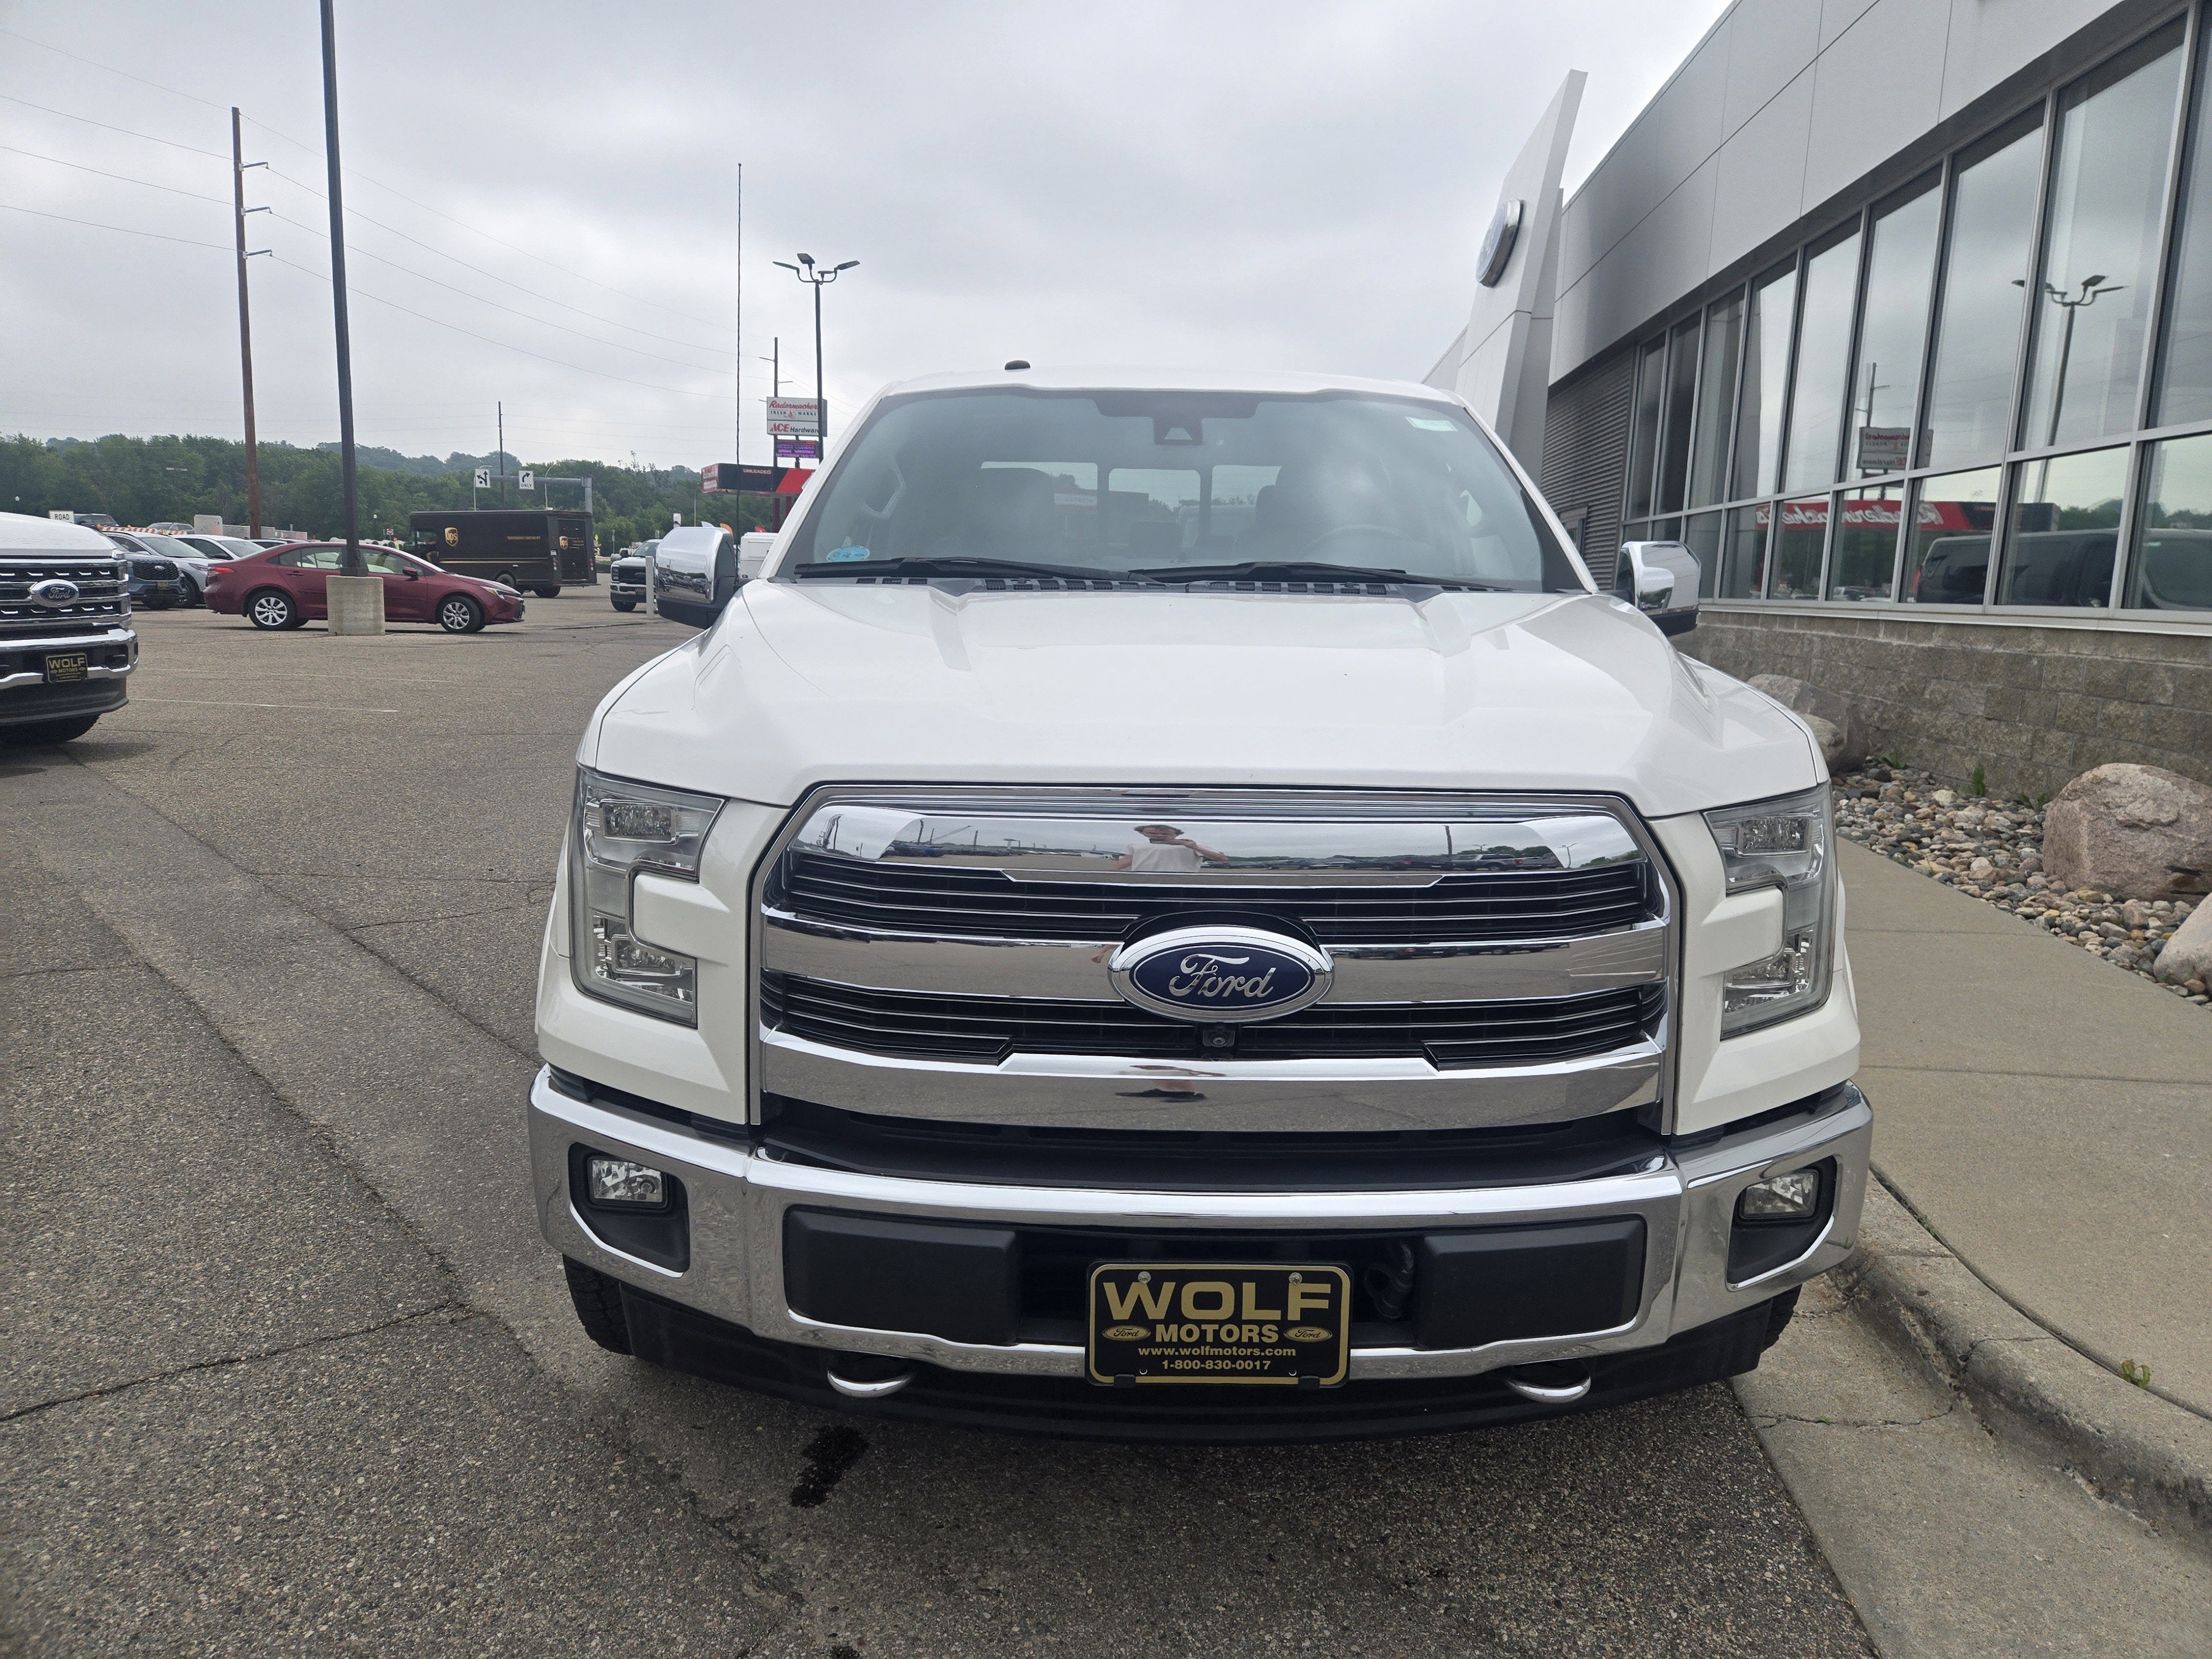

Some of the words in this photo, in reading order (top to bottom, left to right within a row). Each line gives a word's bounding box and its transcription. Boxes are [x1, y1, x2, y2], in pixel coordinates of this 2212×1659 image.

[769, 400, 818, 410] Radermacher
[770, 422, 790, 432] ACE
[49, 587, 70, 598] Ford
[48, 657, 85, 669] WOLF
[1168, 952, 1276, 998] Ford
[1103, 1281, 1331, 1321] WOLF
[1113, 1328, 1140, 1338] Ford
[1155, 1324, 1279, 1343] MOTORS
[1294, 1329, 1322, 1339] Ford
[1138, 1345, 1296, 1357] www.wolfmotors.com
[1162, 1360, 1271, 1370] 1-800-830-0017
